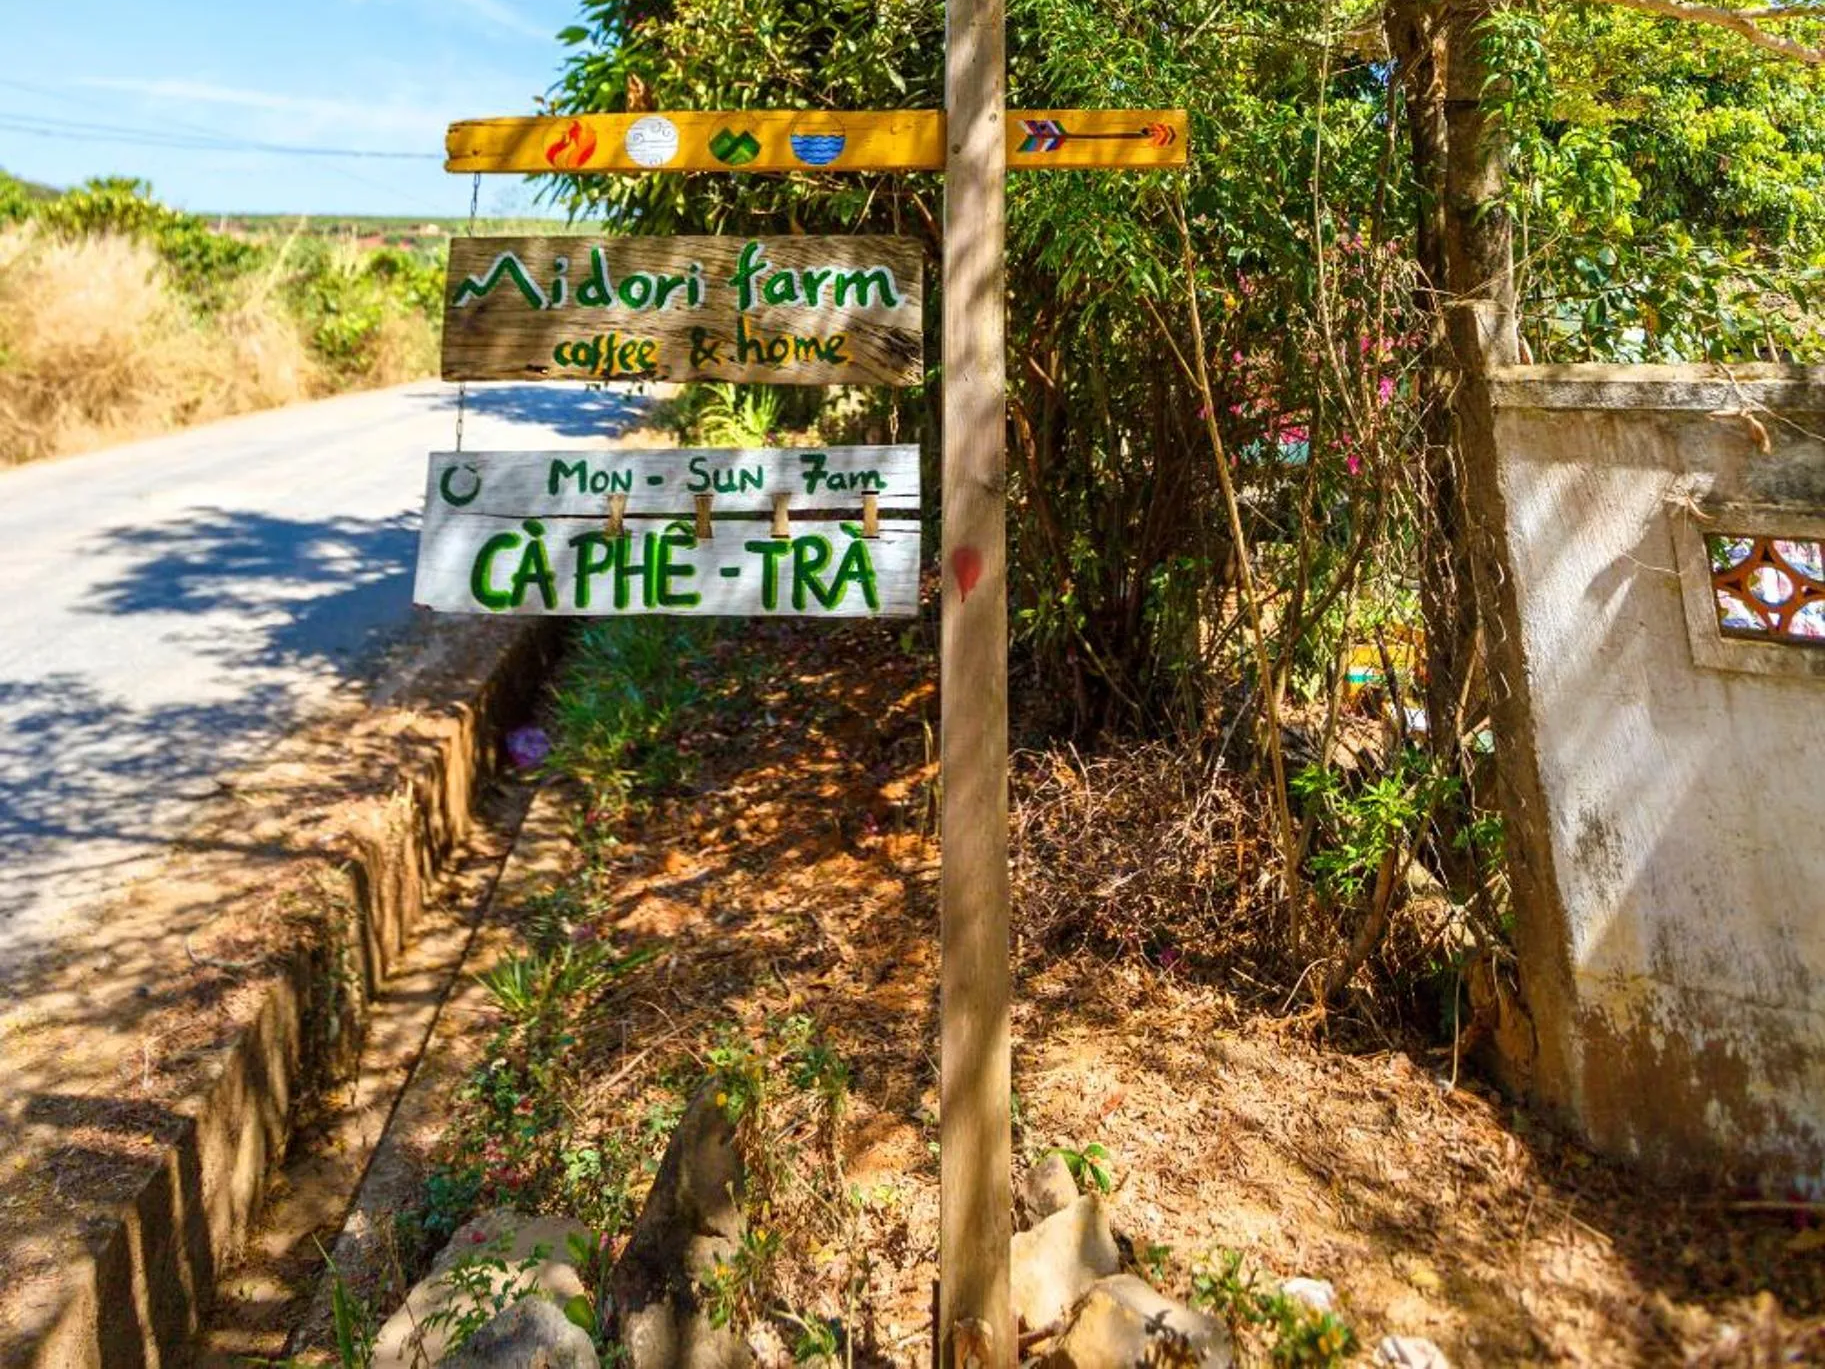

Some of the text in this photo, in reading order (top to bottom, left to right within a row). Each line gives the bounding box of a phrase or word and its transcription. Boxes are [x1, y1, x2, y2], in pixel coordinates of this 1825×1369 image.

[451, 240, 906, 311] Midori farm
[553, 313, 851, 375] coffee & home
[799, 453, 887, 495] 7am
